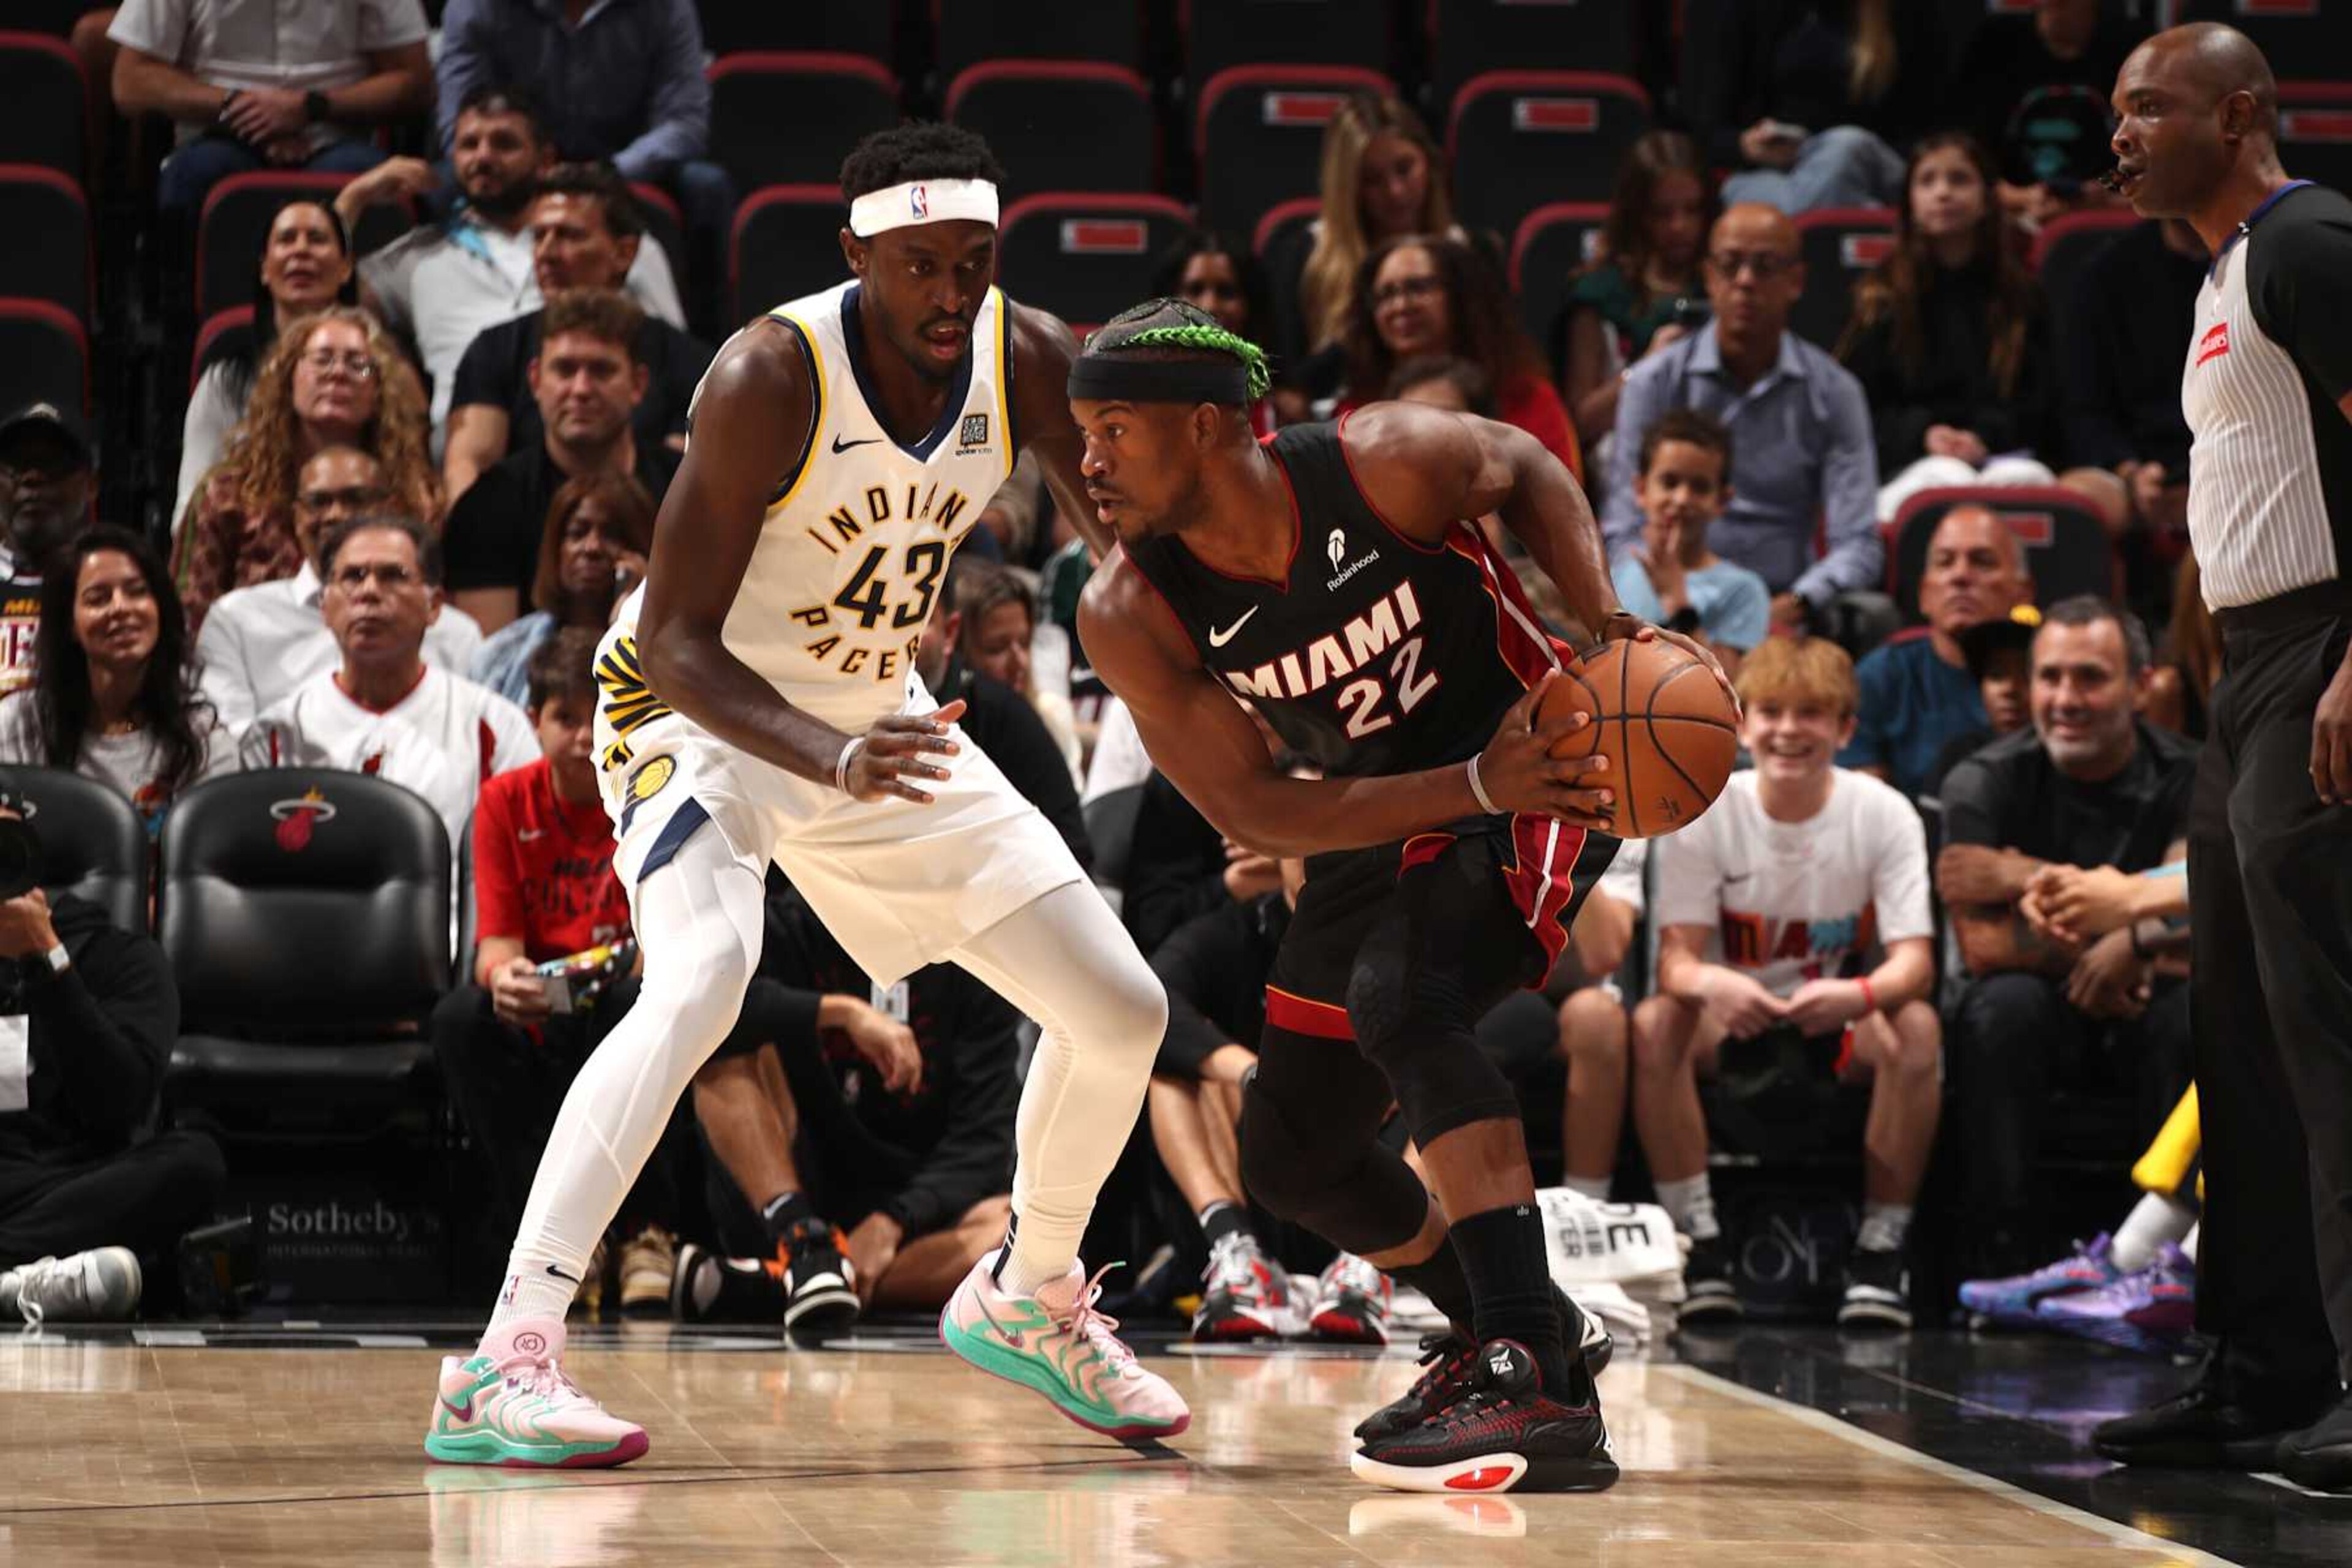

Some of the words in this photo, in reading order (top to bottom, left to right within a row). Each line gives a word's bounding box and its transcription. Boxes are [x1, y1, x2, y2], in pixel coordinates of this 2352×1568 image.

[834, 541, 946, 629] 43
[1327, 549, 1380, 592] Robinhood
[1225, 580, 1421, 699] MIAMI
[1337, 637, 1438, 739] 22
